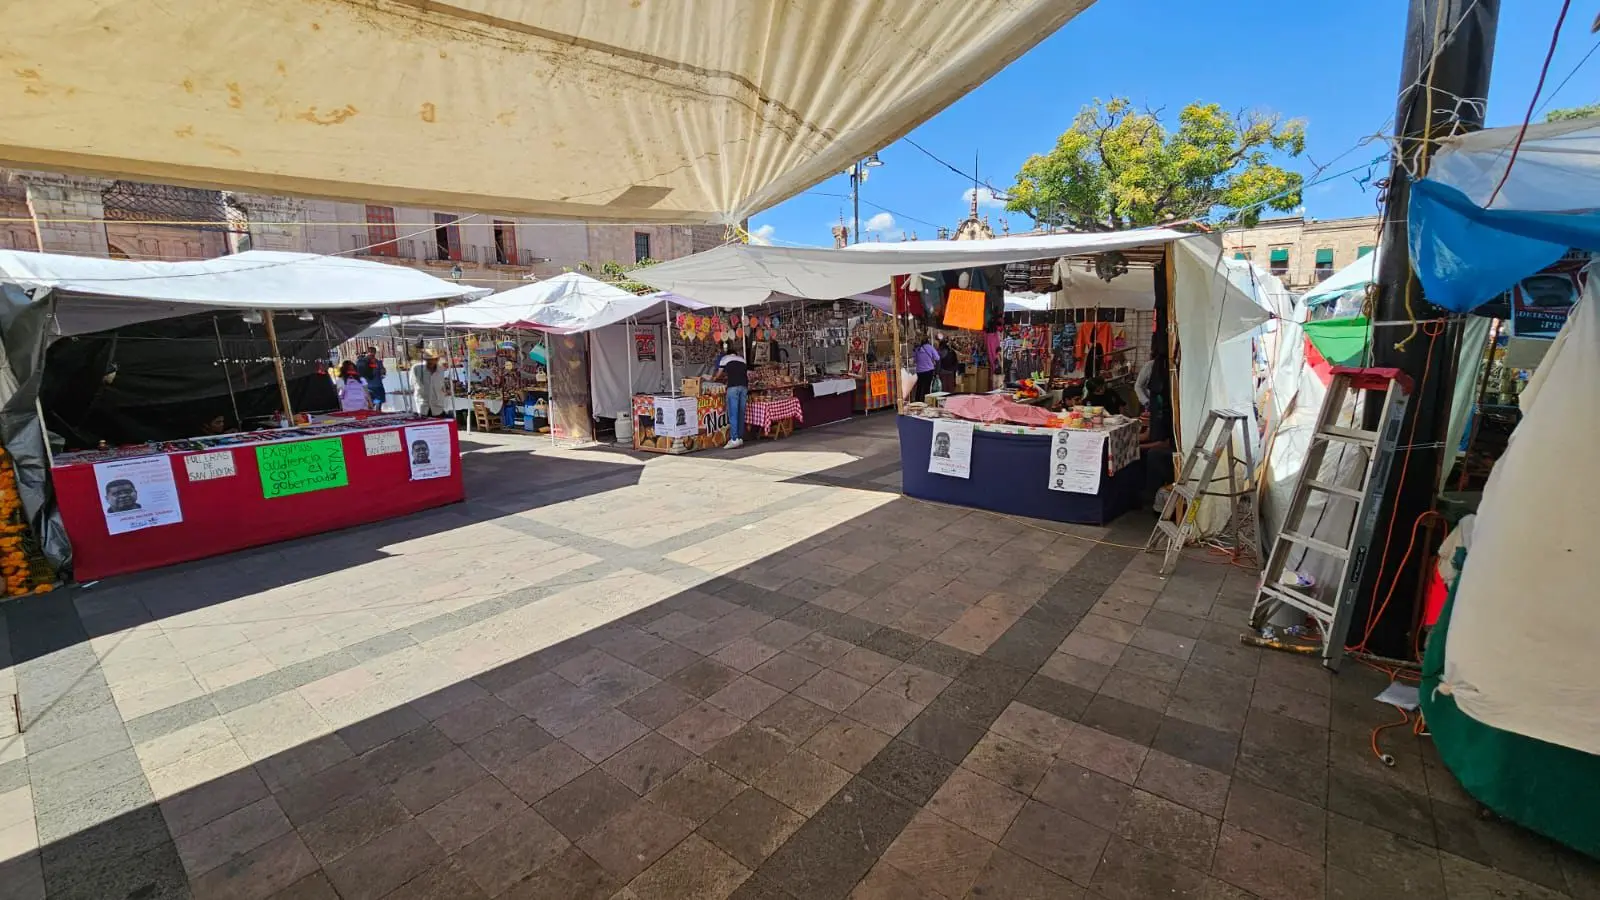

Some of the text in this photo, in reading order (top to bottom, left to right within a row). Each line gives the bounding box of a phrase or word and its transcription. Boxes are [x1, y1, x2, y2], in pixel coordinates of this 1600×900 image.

[263, 453, 321, 471] audiencia
[269, 463, 323, 481] con el
[271, 472, 339, 495] gobernador
